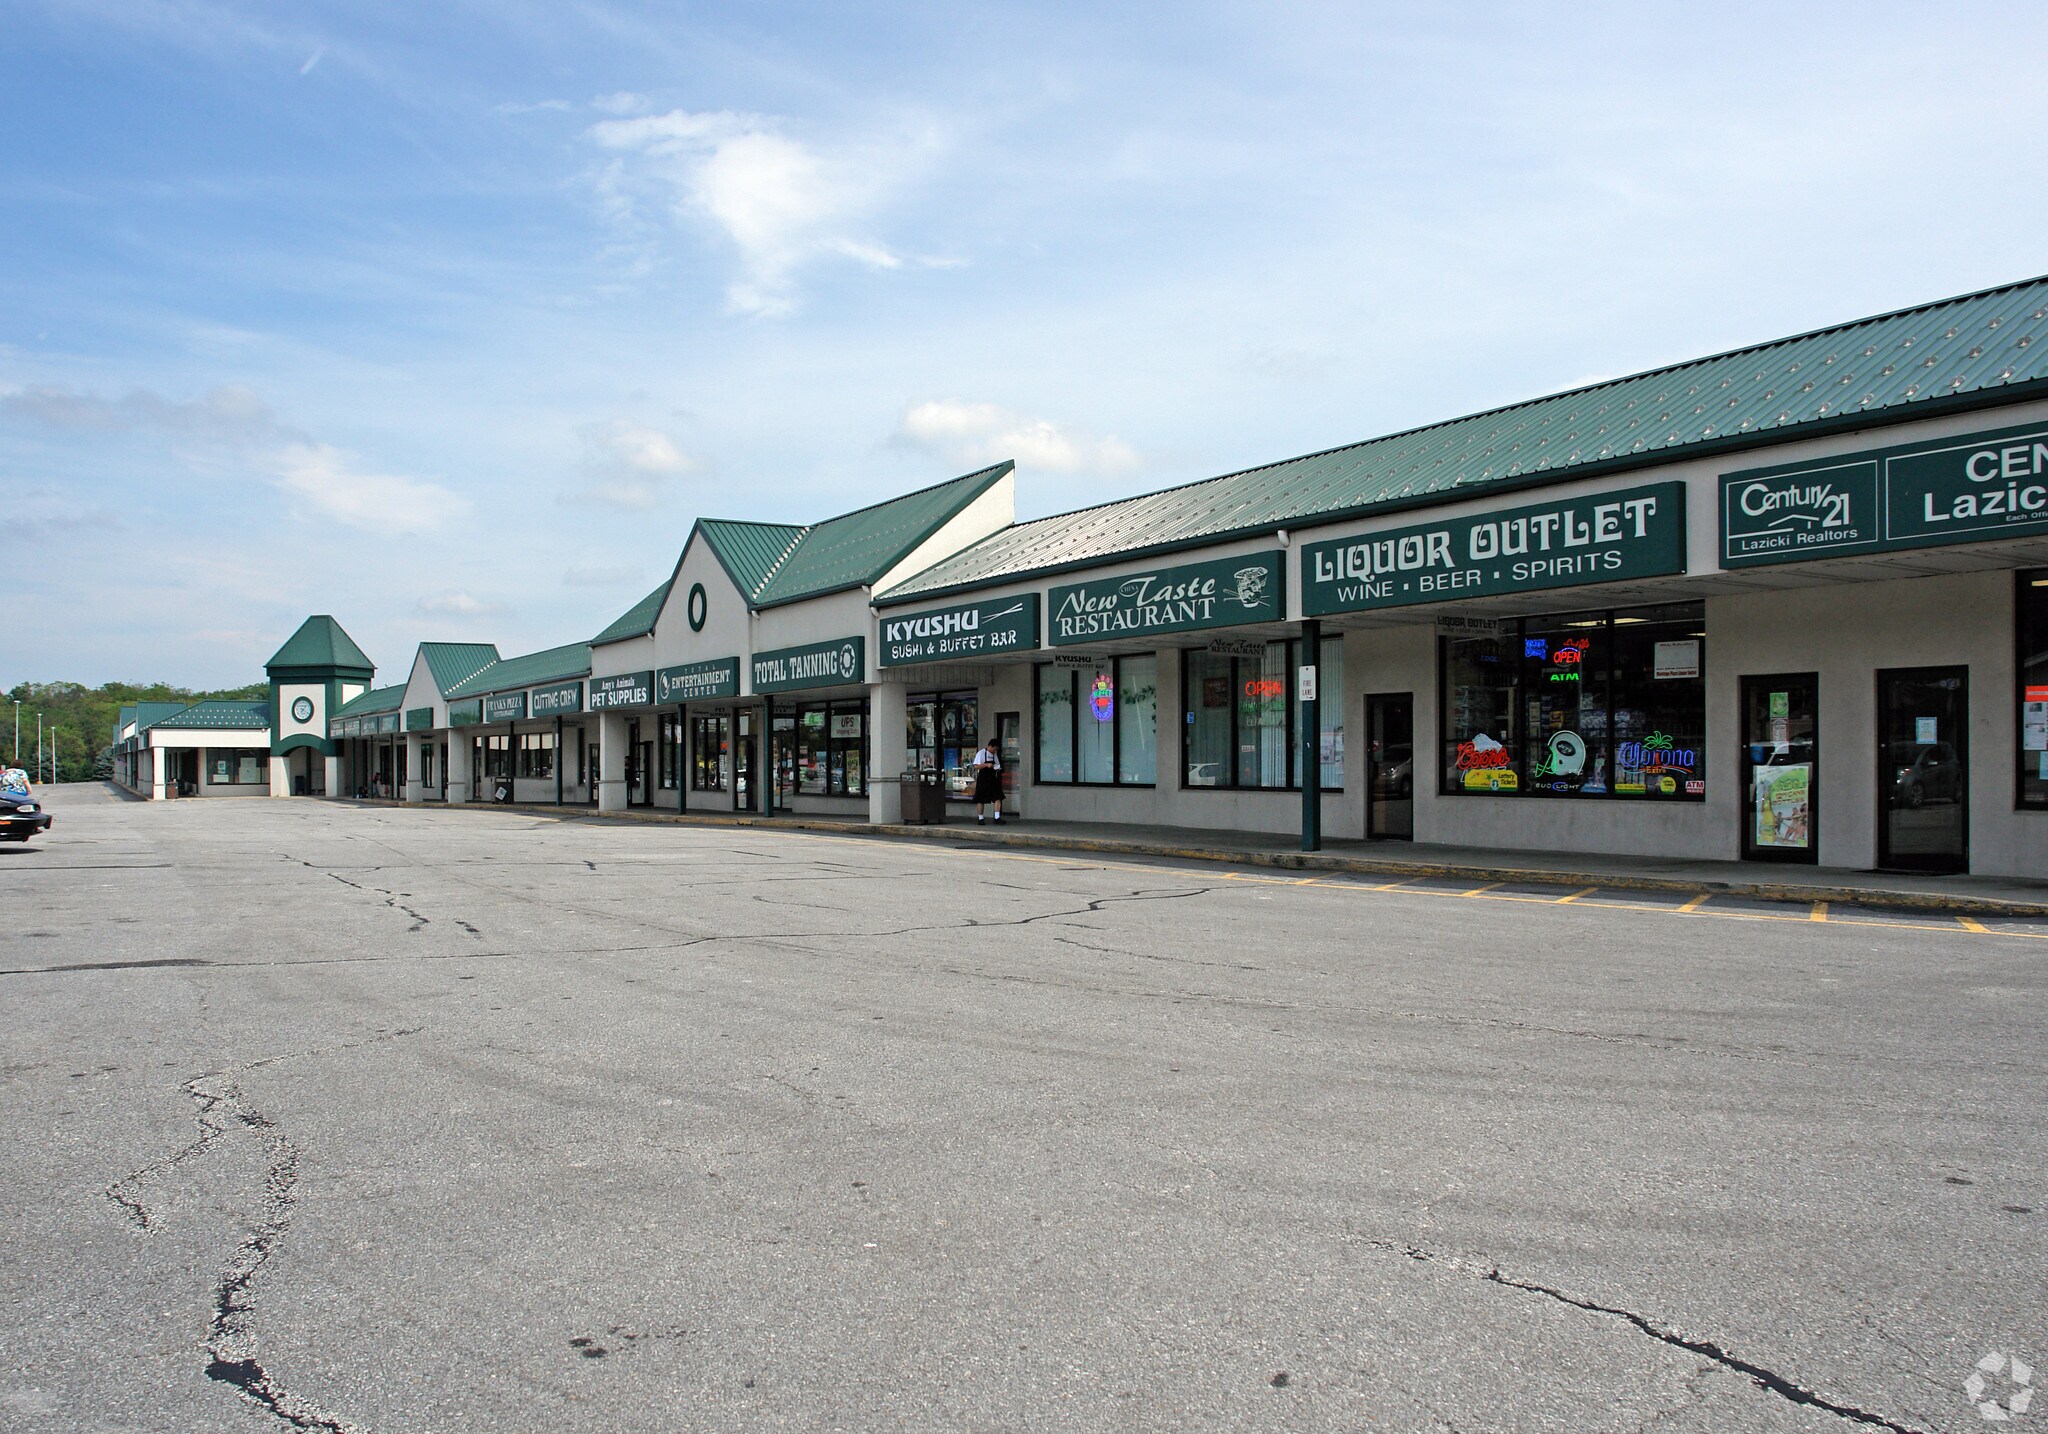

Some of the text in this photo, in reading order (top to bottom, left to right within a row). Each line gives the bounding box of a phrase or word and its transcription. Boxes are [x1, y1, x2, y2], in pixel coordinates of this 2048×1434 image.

[1965, 443, 2048, 482] CEN
[1740, 483, 1849, 527] Century 21
[1924, 481, 2047, 522] Lazic
[2006, 513, 2027, 522] Each
[1314, 497, 1656, 583] LIQUOR OUTLET
[1742, 529, 1858, 551] Lazicki Realtors
[1338, 550, 1622, 602] WINE BEER SPIRITS
[1055, 576, 1216, 622] New Taste
[1120, 585, 1139, 593] CHINA
[886, 609, 979, 642] KYUSHU
[1060, 597, 1216, 637] RESTAURANT
[1437, 615, 1497, 630] LIQUOR OUTLET
[891, 629, 1017, 659] SUSHI & BUFFET BAR
[1211, 646, 1266, 655] RESTAURANT
[754, 650, 838, 684] TOTAL TANNING
[1055, 655, 1092, 663] KYUSHU
[1553, 651, 1581, 663] OPEN
[671, 669, 731, 689] ENTERTAINMENT
[684, 664, 716, 674] TOTAL
[1550, 672, 1580, 681] ATM
[601, 677, 635, 691] Amy's Animals
[683, 685, 717, 698] CENTER
[1245, 680, 1283, 697] OPEN
[506, 697, 522, 708] PIZZA
[533, 688, 577, 710] CUTTING CREW
[591, 687, 647, 707] PET SUPPLIES
[841, 716, 854, 728] UPS
[1457, 742, 1510, 770] Coors
[1619, 741, 1694, 768] Corona
